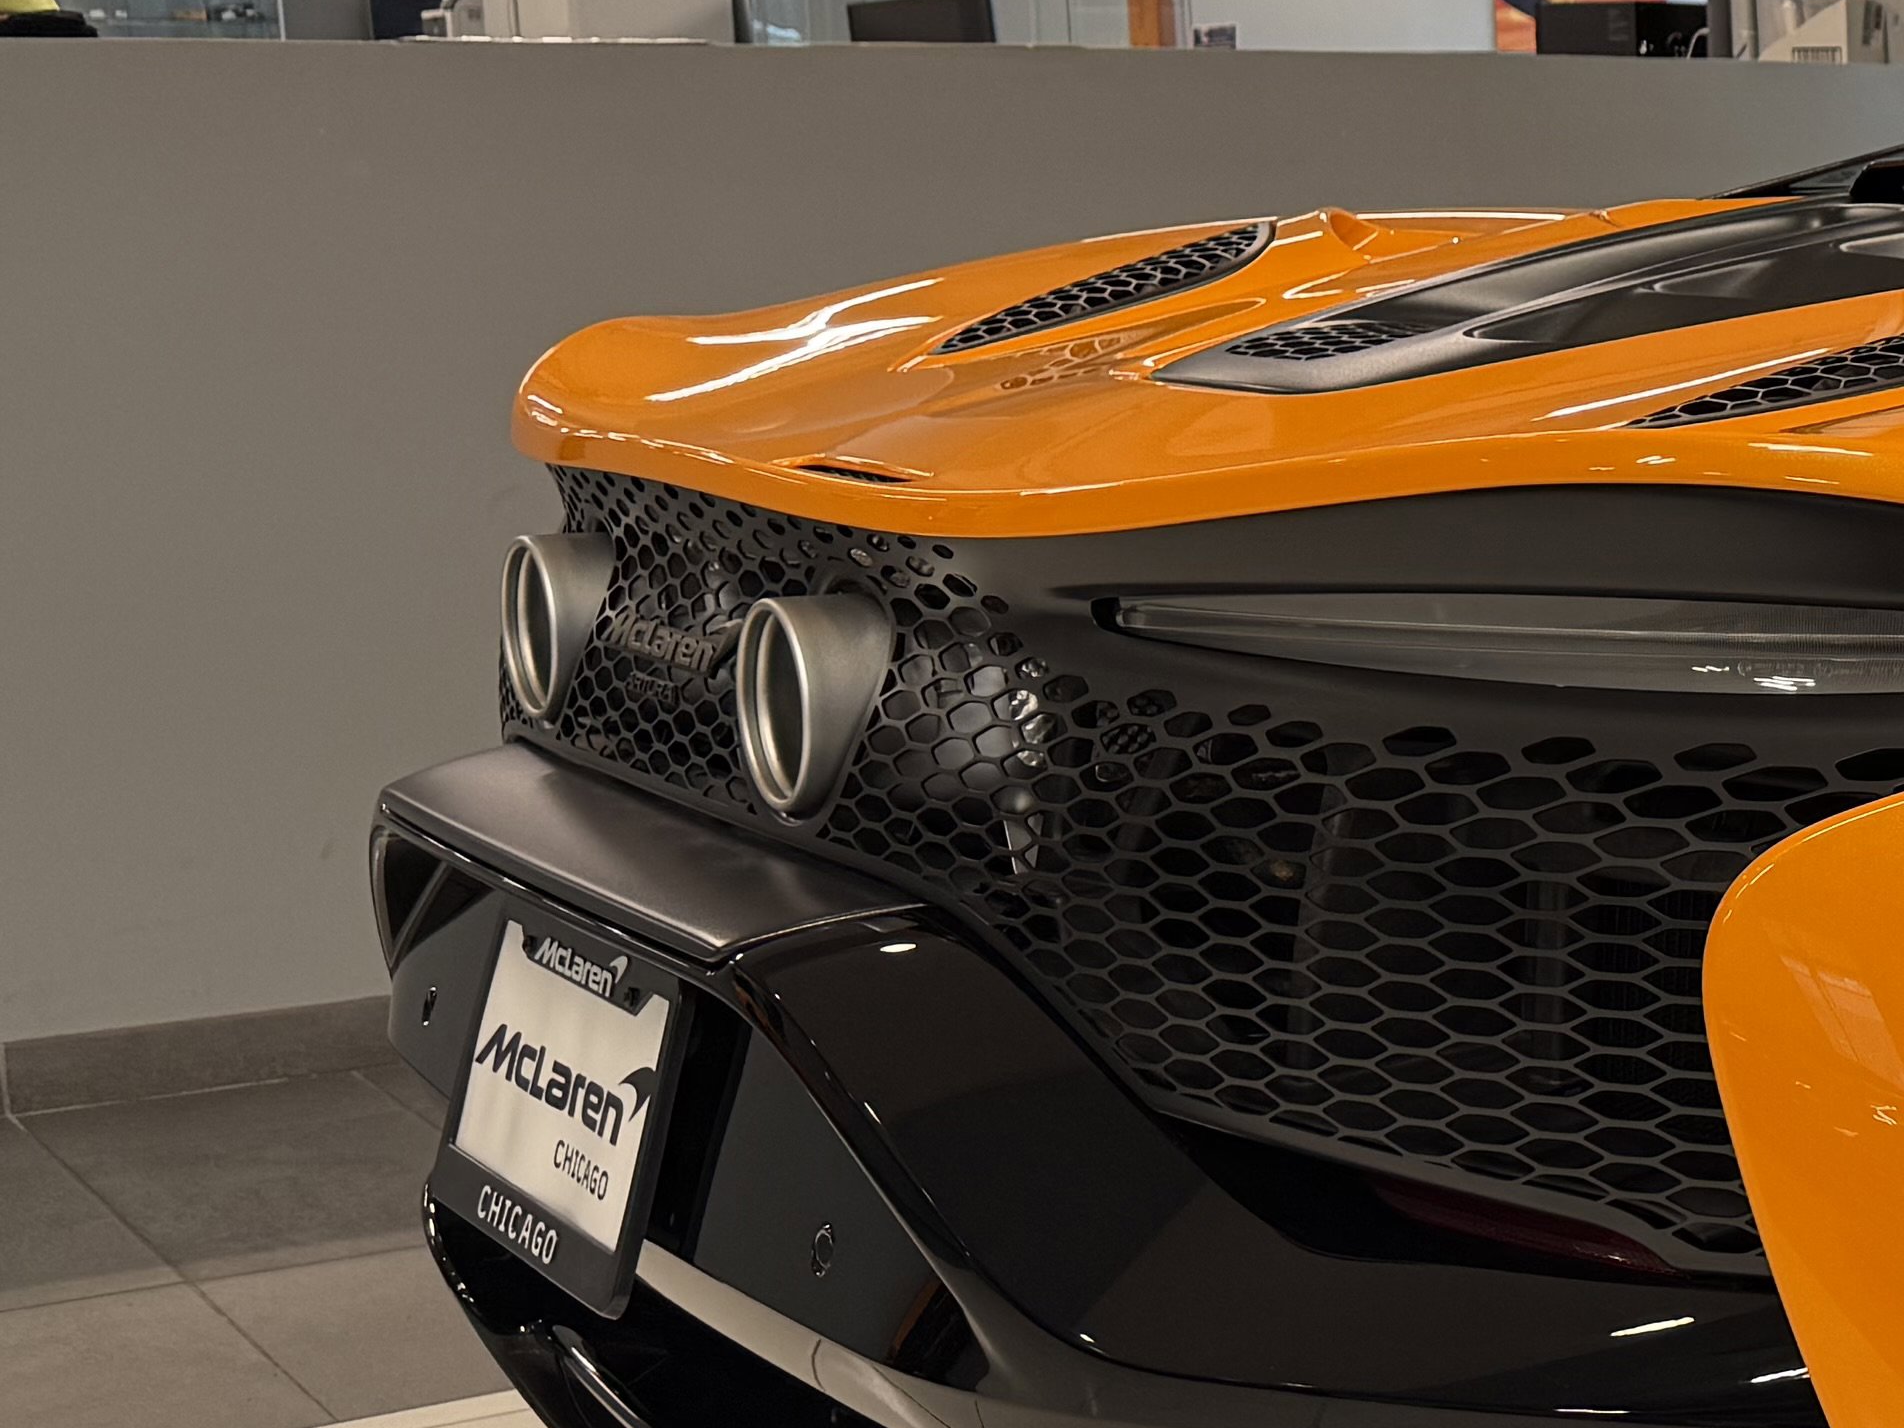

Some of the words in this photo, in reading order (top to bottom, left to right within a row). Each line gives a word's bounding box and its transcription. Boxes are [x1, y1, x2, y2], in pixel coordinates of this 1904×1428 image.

[600, 608, 715, 674] McLaren
[532, 935, 614, 998] McLaren
[473, 1022, 627, 1147] McLaren
[552, 1138, 610, 1202] CHICAGO
[476, 1182, 559, 1266] CHICAGO
